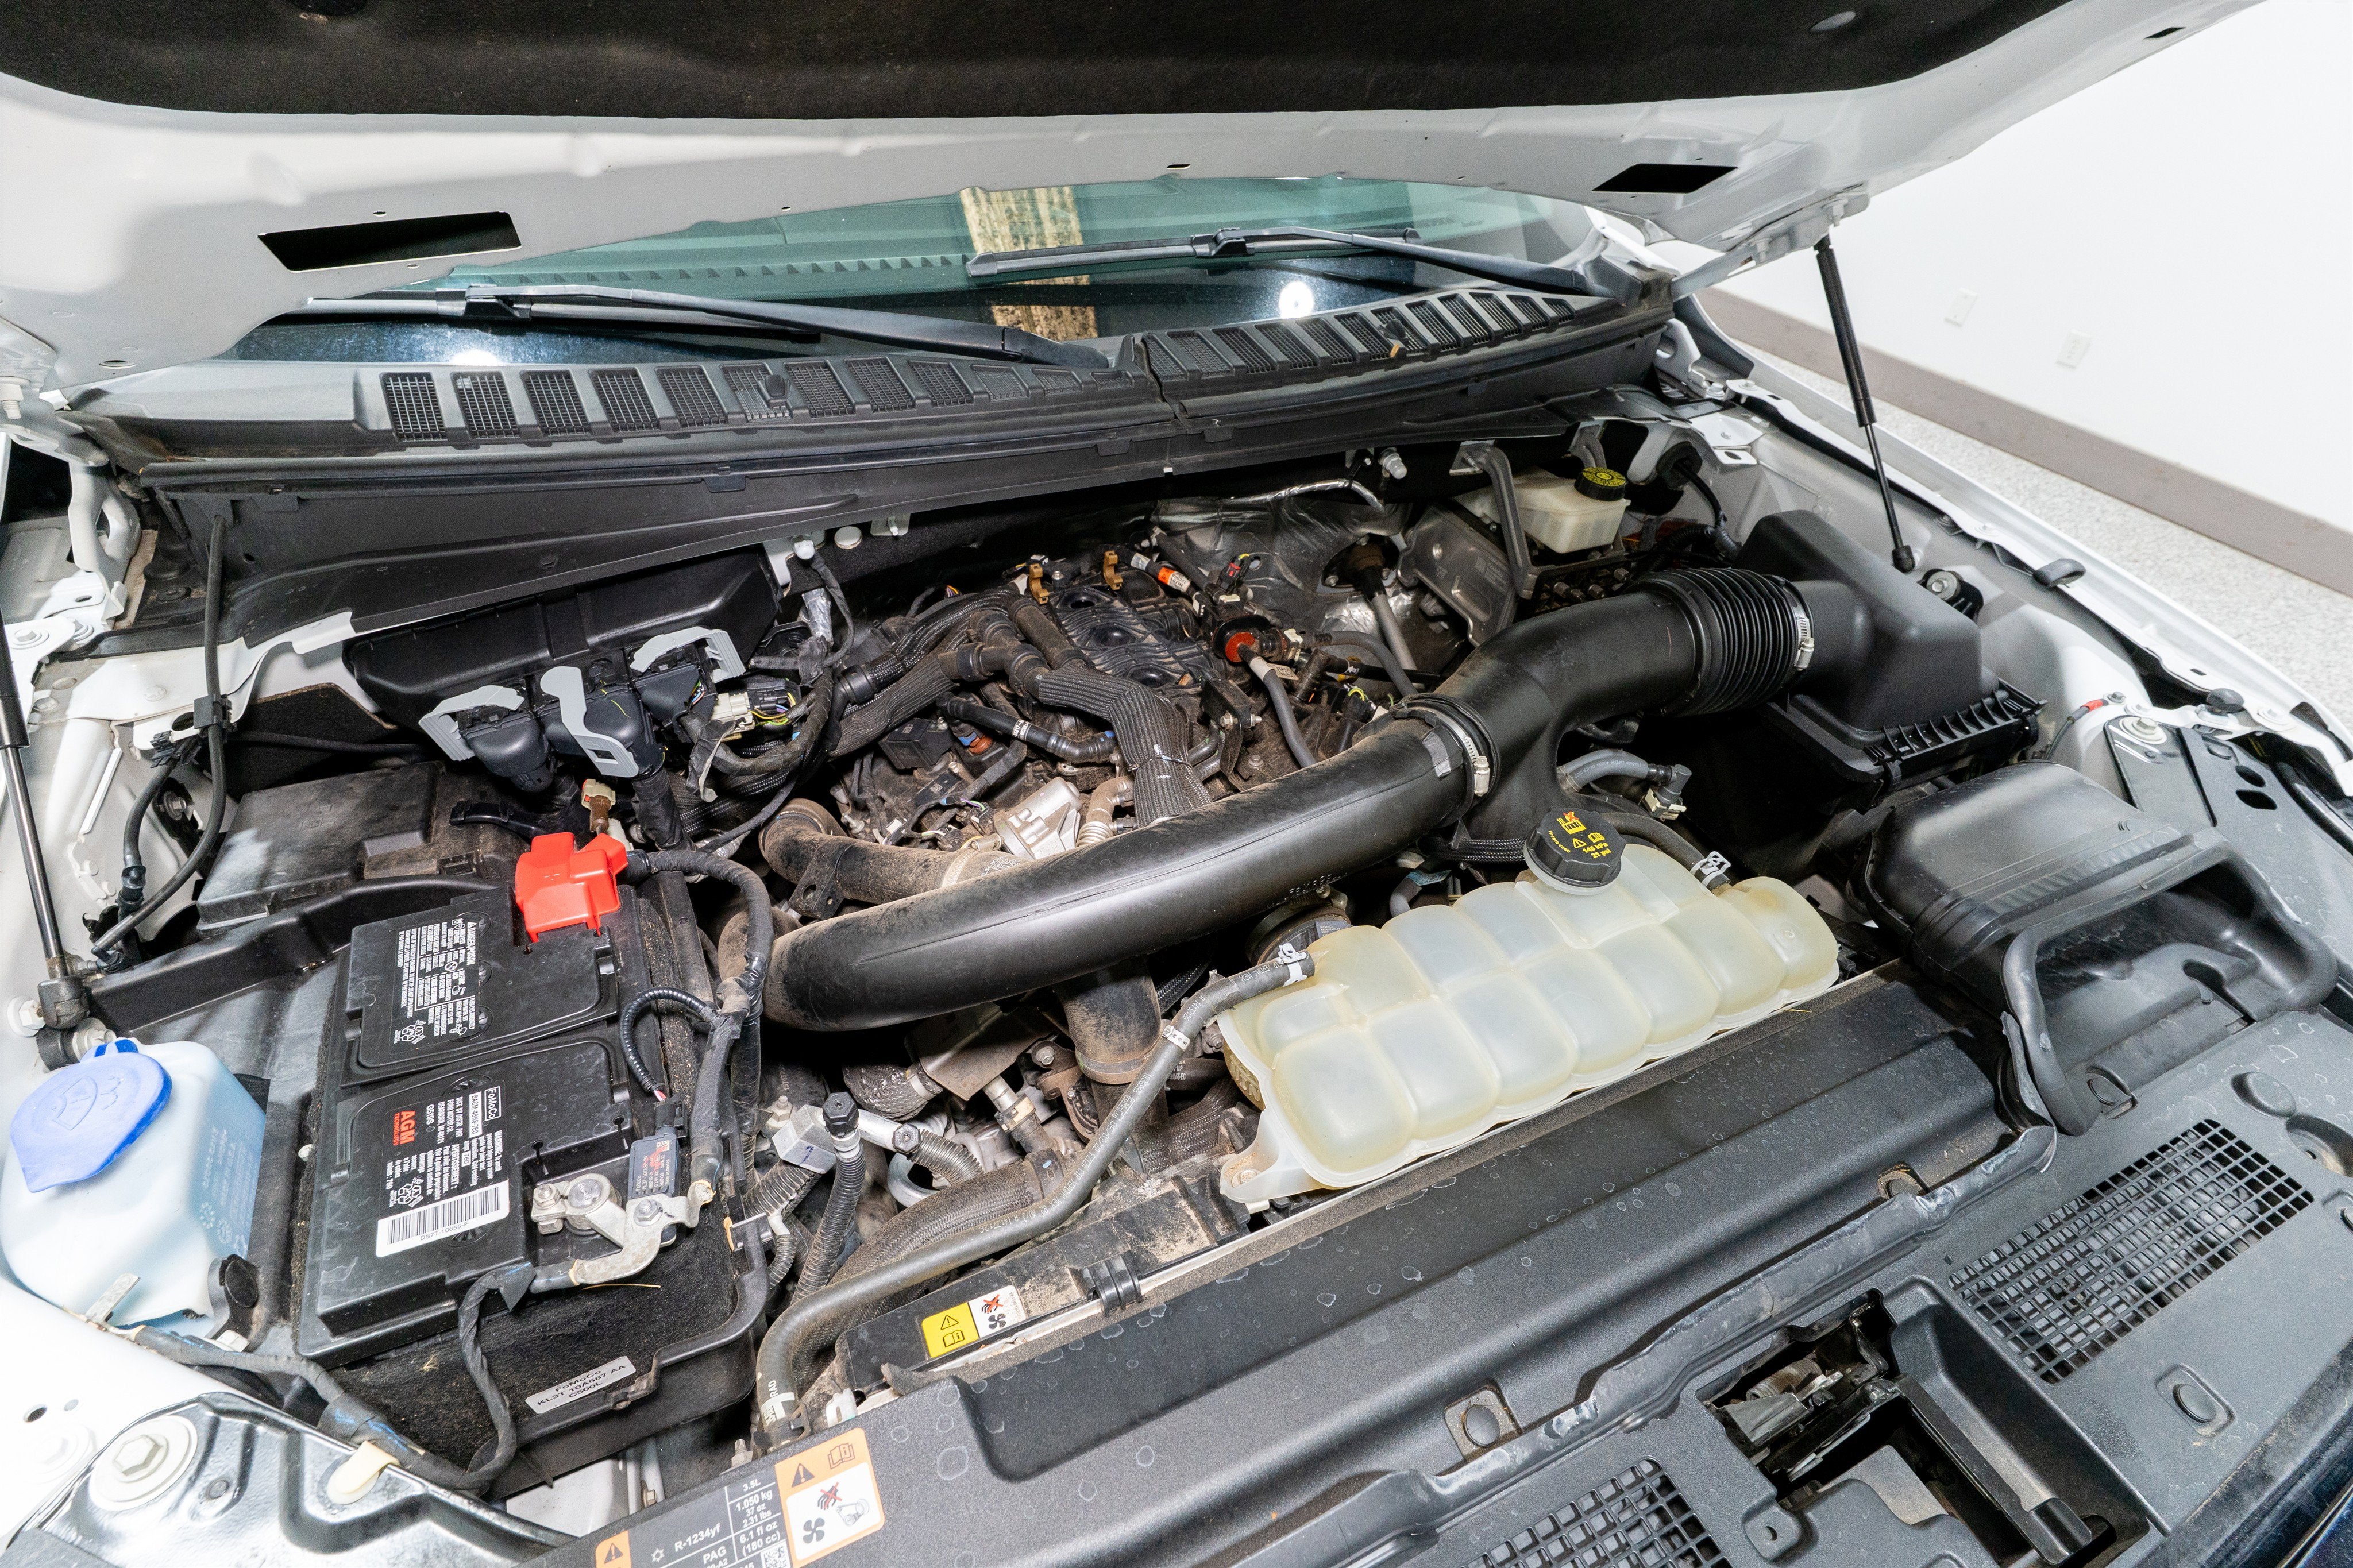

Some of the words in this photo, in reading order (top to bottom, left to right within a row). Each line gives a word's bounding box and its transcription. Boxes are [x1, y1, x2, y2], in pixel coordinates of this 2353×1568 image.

[1583, 845, 1596, 853] 145
[1600, 848, 1612, 856] psi
[466, 927, 476, 965] DANGER/POISON
[488, 1088, 497, 1118] FoMoCo
[426, 1104, 434, 1125] G519S
[399, 1111, 415, 1144] AGM
[446, 1125, 454, 1134] CO.
[455, 1127, 463, 1137] PAR
[494, 1130, 503, 1155] WARNING:
[450, 1144, 460, 1184] AVERTISSEMENT
[537, 1391, 565, 1405] KL3T
[569, 1373, 606, 1392] 10A687
[610, 1365, 626, 1374] AA
[555, 1370, 601, 1392] FoMoCo
[569, 1382, 603, 1398] C500L
[767, 1380, 778, 1397] RAD
[743, 1479, 761, 1492] 3.5L
[736, 1494, 759, 1512] 1.050
[761, 1490, 773, 1501] kg
[746, 1507, 754, 1517] 37
[757, 1503, 766, 1512] oz
[743, 1516, 758, 1528] 2.31
[760, 1510, 772, 1520] lbs
[674, 1523, 720, 1552] R-1234yf
[739, 1531, 754, 1544] 6.1
[756, 1525, 763, 1534] fl
[766, 1521, 778, 1531] oz
[742, 1539, 763, 1557] (180
[765, 1530, 781, 1544] cc)
[703, 1546, 727, 1565] PAG
